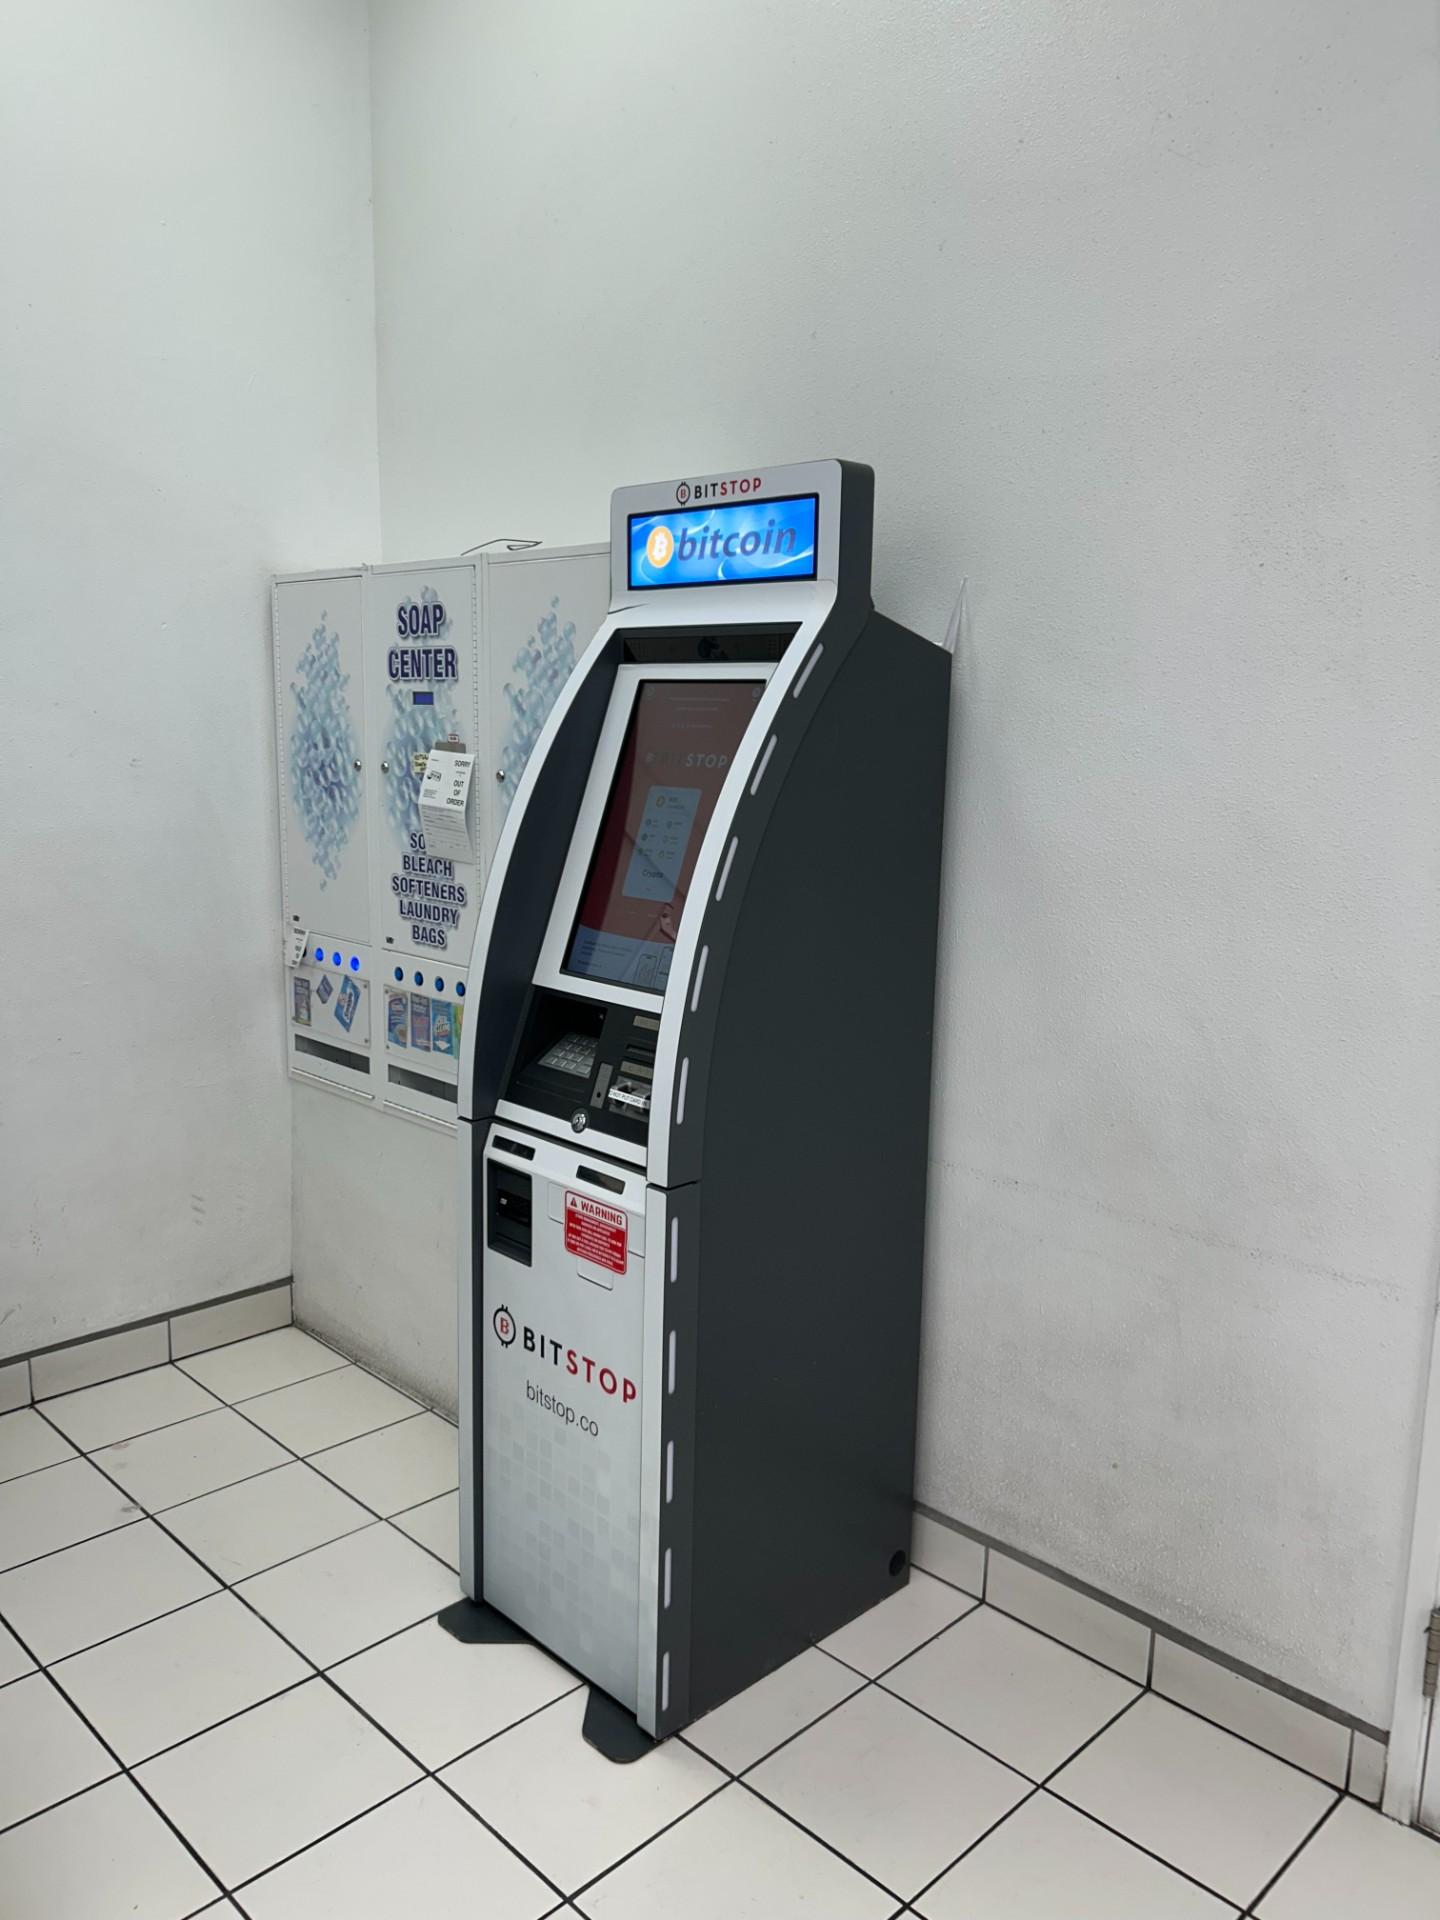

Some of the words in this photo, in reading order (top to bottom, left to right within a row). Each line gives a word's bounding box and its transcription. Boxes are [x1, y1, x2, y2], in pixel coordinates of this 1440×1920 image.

[694, 477, 762, 499] BITSTOP
[677, 518, 796, 561] bitcoin
[397, 603, 444, 636] SOAP
[388, 647, 457, 679] CENTER
[410, 832, 426, 850] SO
[403, 854, 452, 877] BLEACH
[392, 875, 465, 903] SOFTENERS
[399, 899, 458, 925] LAUNDRY
[412, 924, 445, 946] BAGS
[580, 1200, 623, 1226] WARNING
[523, 1325, 637, 1404] BITSTOP
[526, 1379, 599, 1437] bitstop.co
